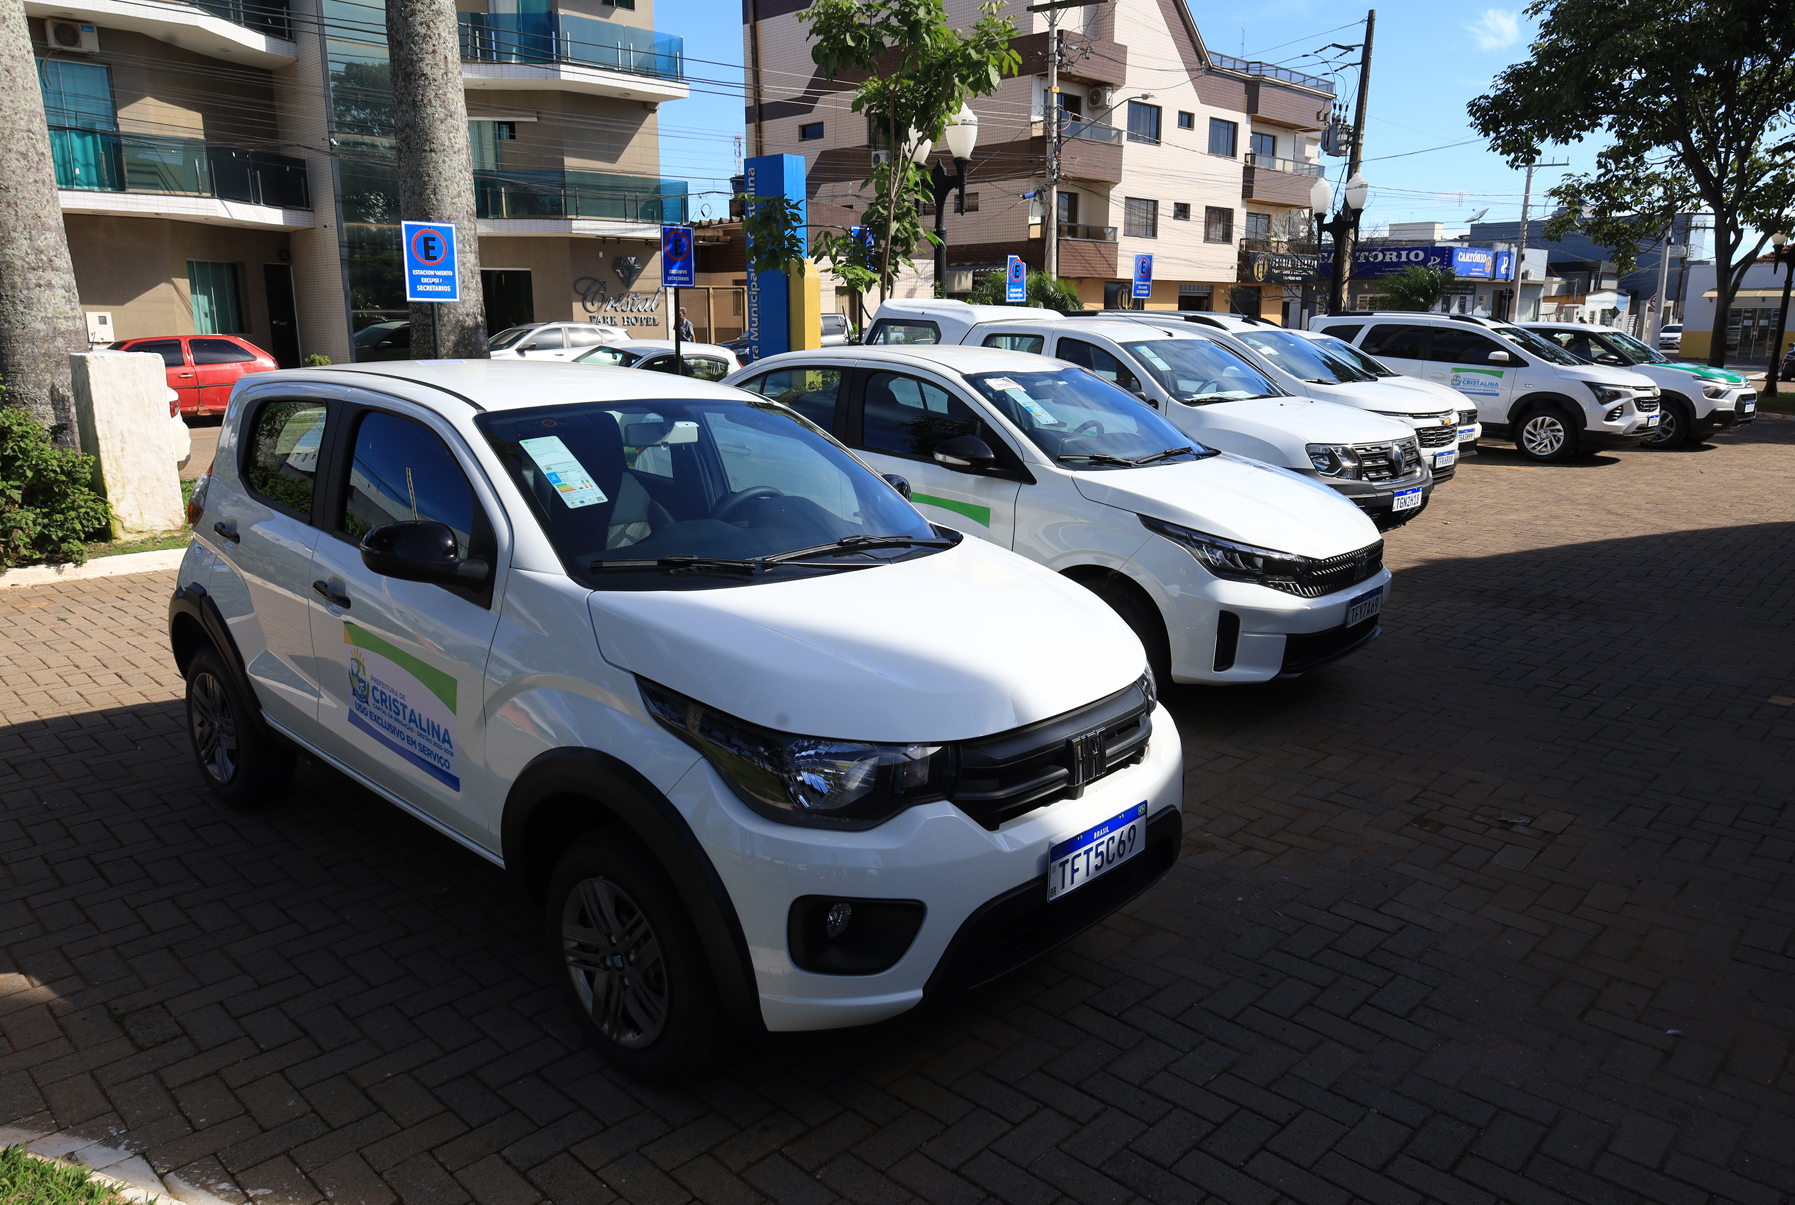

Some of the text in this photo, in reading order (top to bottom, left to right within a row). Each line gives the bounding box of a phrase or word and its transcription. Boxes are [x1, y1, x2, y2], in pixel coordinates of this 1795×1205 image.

[747, 167, 757, 239] Cstlina
[423, 236, 438, 260] E
[674, 238, 683, 255] E
[1319, 248, 1425, 263] CTÓRIO
[1457, 250, 1487, 263] CARTÓRIO
[573, 276, 663, 313] Cristal
[748, 268, 761, 341] Municipal
[589, 315, 660, 326] PARK HOTEL
[1461, 379, 1499, 387] CRISTALINA
[370, 675, 406, 701] PREFEITURA DE
[371, 685, 453, 750] CRISTALINA
[354, 701, 451, 770] USO EXCLUSIVO EM SERVIÇO
[1072, 726, 1107, 786] FIAT
[1093, 825, 1110, 839] BRASIL
[1058, 823, 1137, 891] TFT5C69
